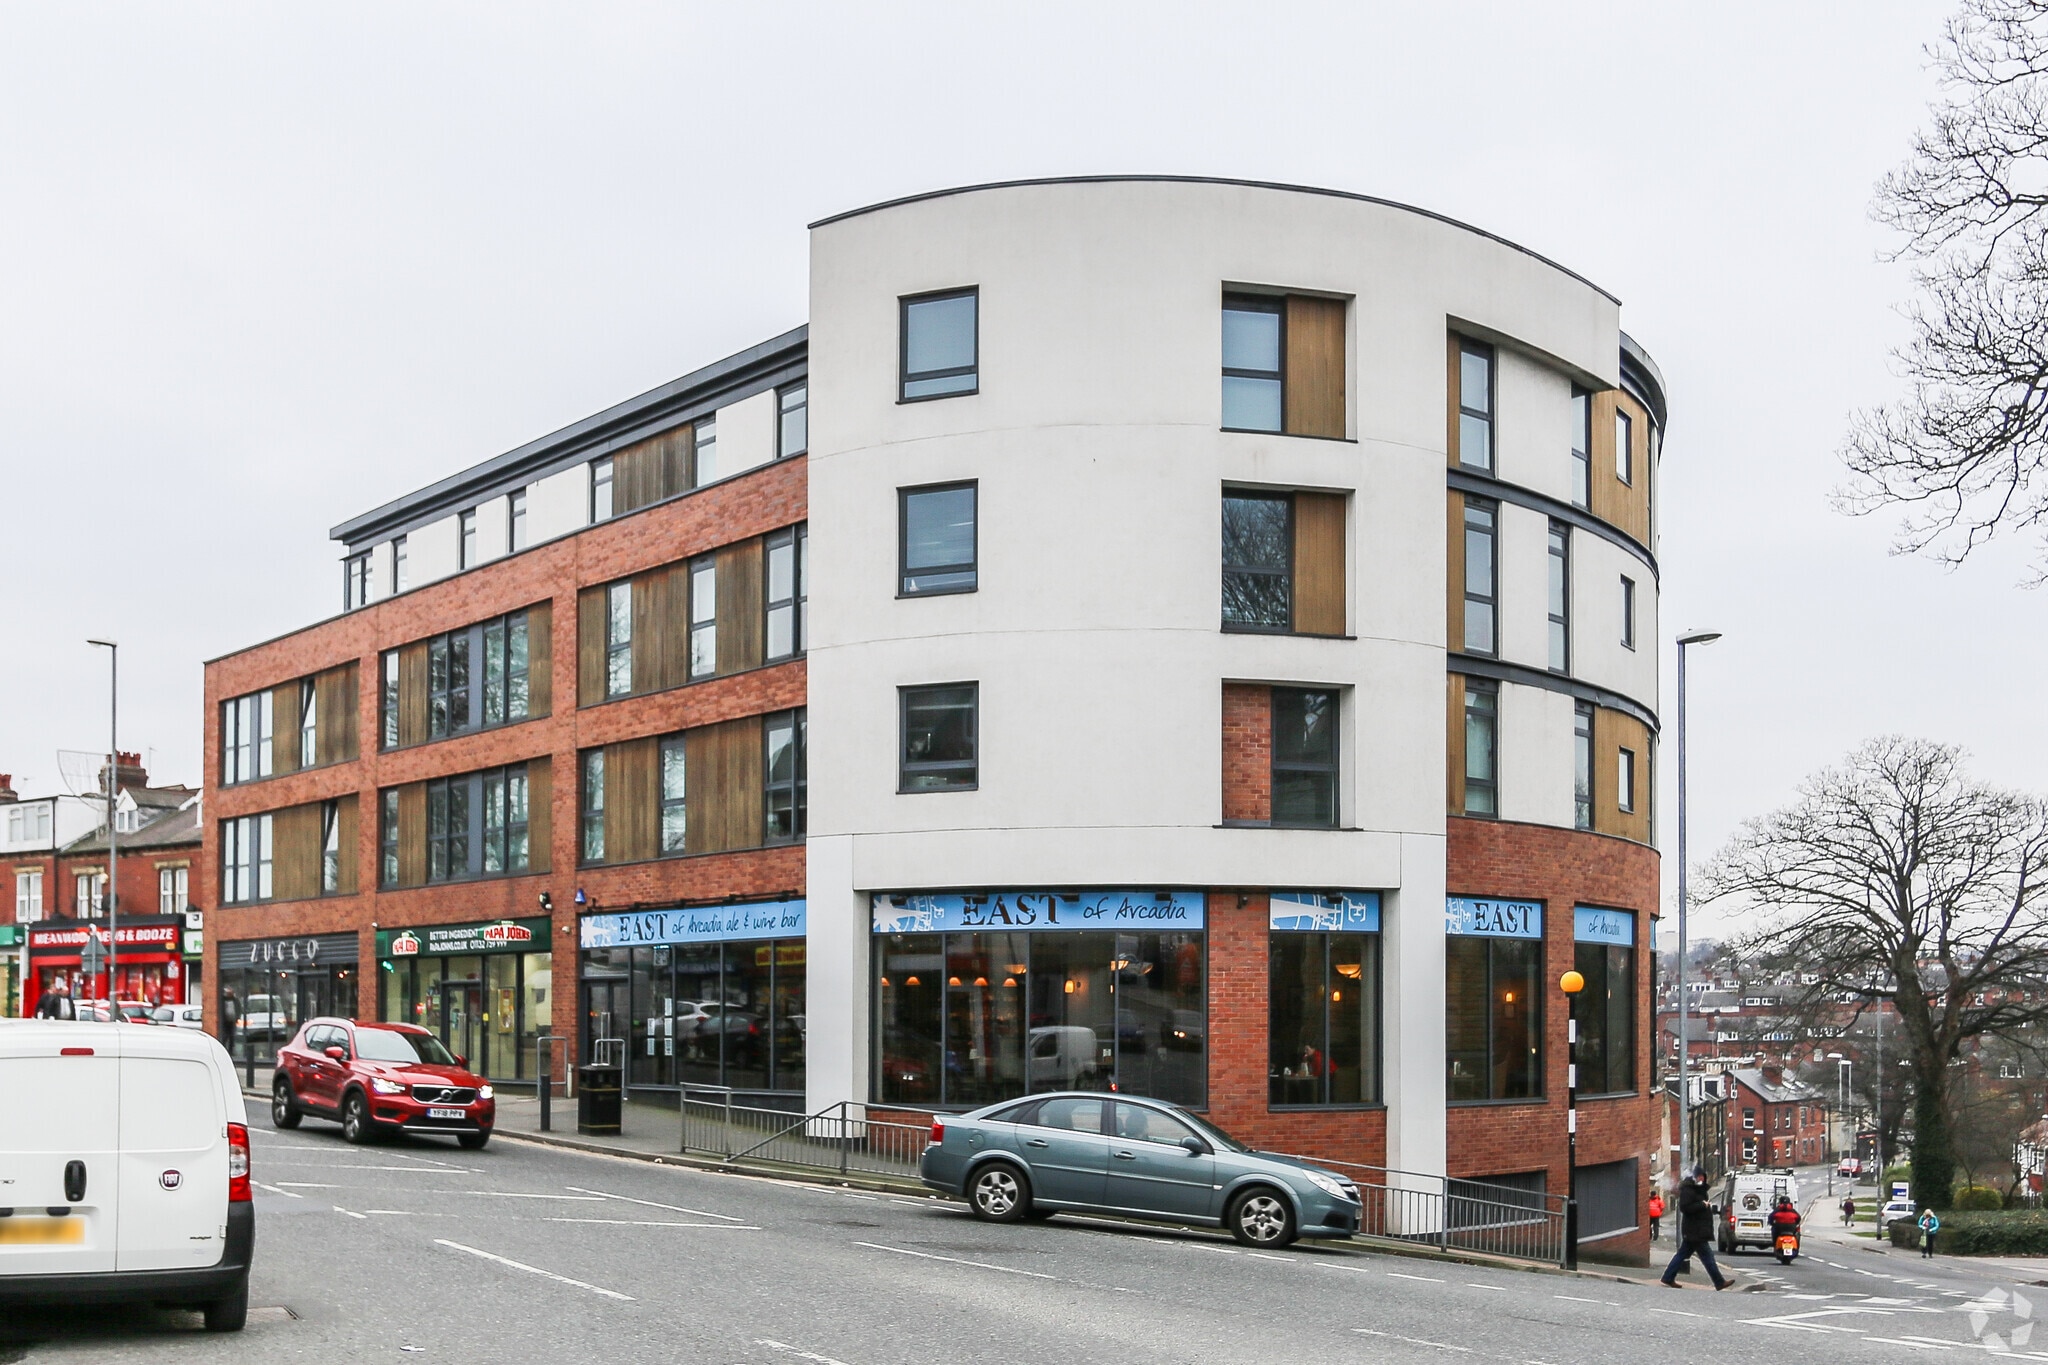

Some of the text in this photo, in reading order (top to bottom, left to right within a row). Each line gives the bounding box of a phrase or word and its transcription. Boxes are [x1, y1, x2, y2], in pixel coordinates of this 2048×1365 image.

[960, 894, 1187, 926] EAST of Arcadia
[1473, 902, 1620, 936] EAST of Arcadia
[96, 930, 126, 942] NES
[126, 929, 135, 941] &
[136, 928, 173, 941] BOOZE
[429, 930, 448, 940] BETTER
[485, 926, 504, 938] PAPA
[618, 908, 800, 942] EAST of Arcadia ale & wine bar
[250, 939, 317, 962] ZUCCO
